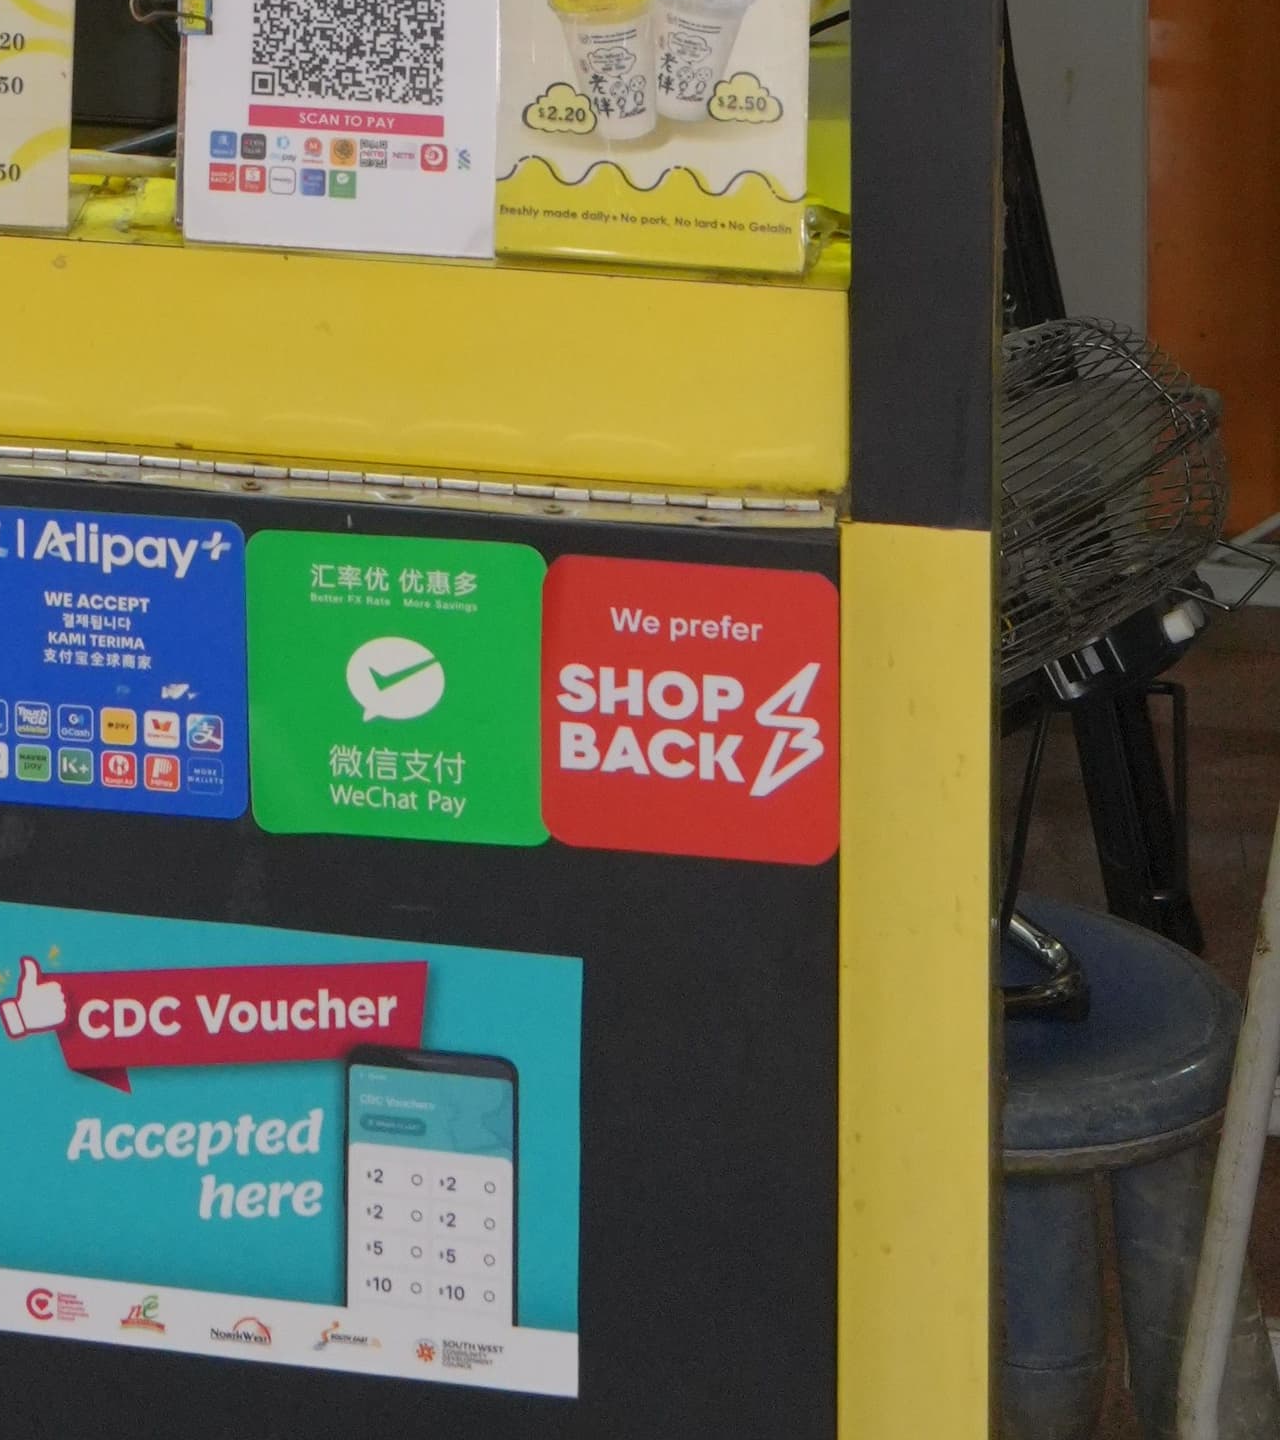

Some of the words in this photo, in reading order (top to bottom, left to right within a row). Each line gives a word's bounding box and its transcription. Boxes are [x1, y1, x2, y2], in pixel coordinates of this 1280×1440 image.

[538, 106, 586, 122] $2.20
[717, 95, 767, 111] $2.50
[299, 112, 340, 126] SCAN
[344, 114, 363, 127] TO
[367, 116, 395, 129] PAY
[310, 563, 390, 592] 汇率优
[398, 568, 478, 597] 优惠多
[44, 591, 74, 609] WE
[77, 594, 150, 614] ACCEPT
[48, 631, 86, 647] KAMI
[90, 634, 145, 651] TERIMA
[610, 606, 662, 635] We
[670, 616, 763, 643] prefer
[43, 648, 152, 670] 支付宝全球商家
[556, 662, 744, 723] SHOP
[329, 745, 466, 784] 微信支付
[560, 721, 745, 784] BACK
[330, 784, 419, 811] WeChat
[427, 791, 466, 818] Pay
[78, 996, 181, 1039] CDC
[195, 988, 398, 1036] Voucher
[67, 1108, 325, 1166] Accepted
[199, 1175, 324, 1221] here
